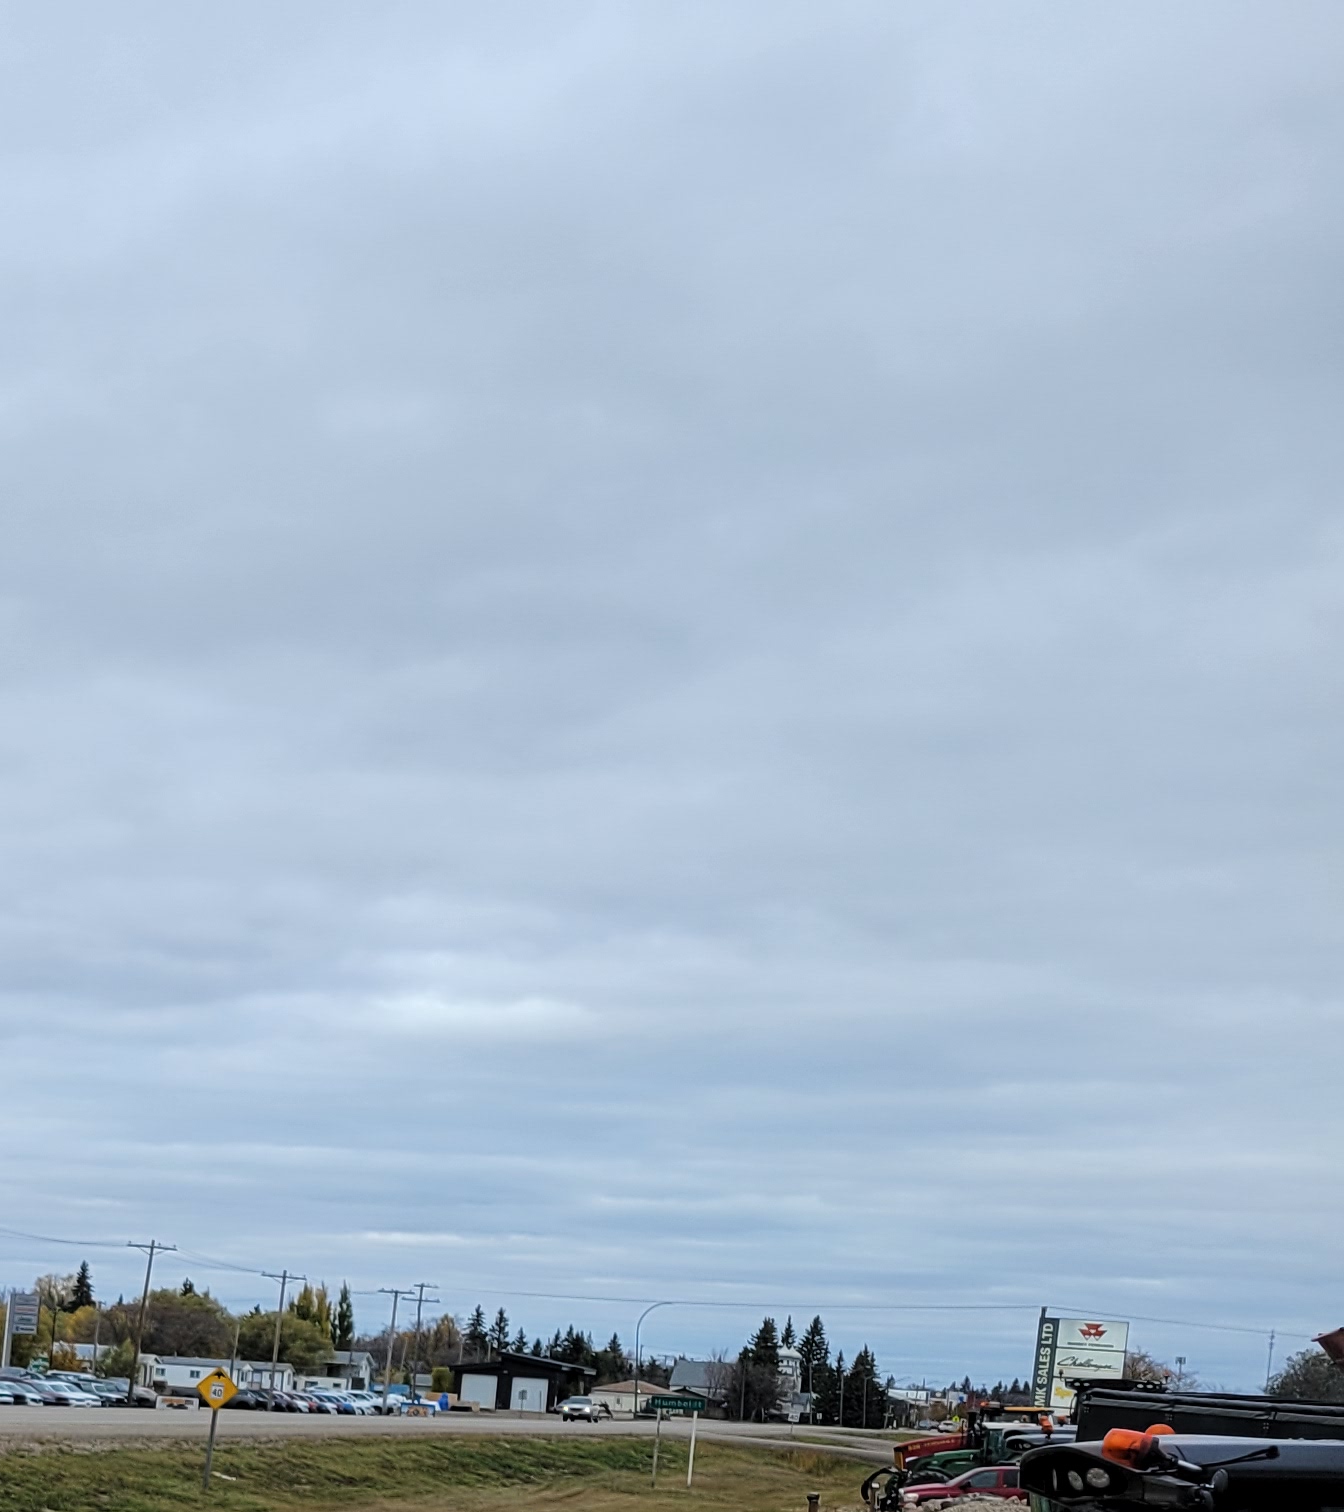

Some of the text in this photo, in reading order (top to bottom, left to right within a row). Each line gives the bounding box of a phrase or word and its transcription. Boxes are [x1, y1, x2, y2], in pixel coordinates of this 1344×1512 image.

[1034, 1323, 1053, 1408] MK SALES LTD
[211, 1387, 223, 1398] 40
[654, 1398, 703, 1409] Humboldt
